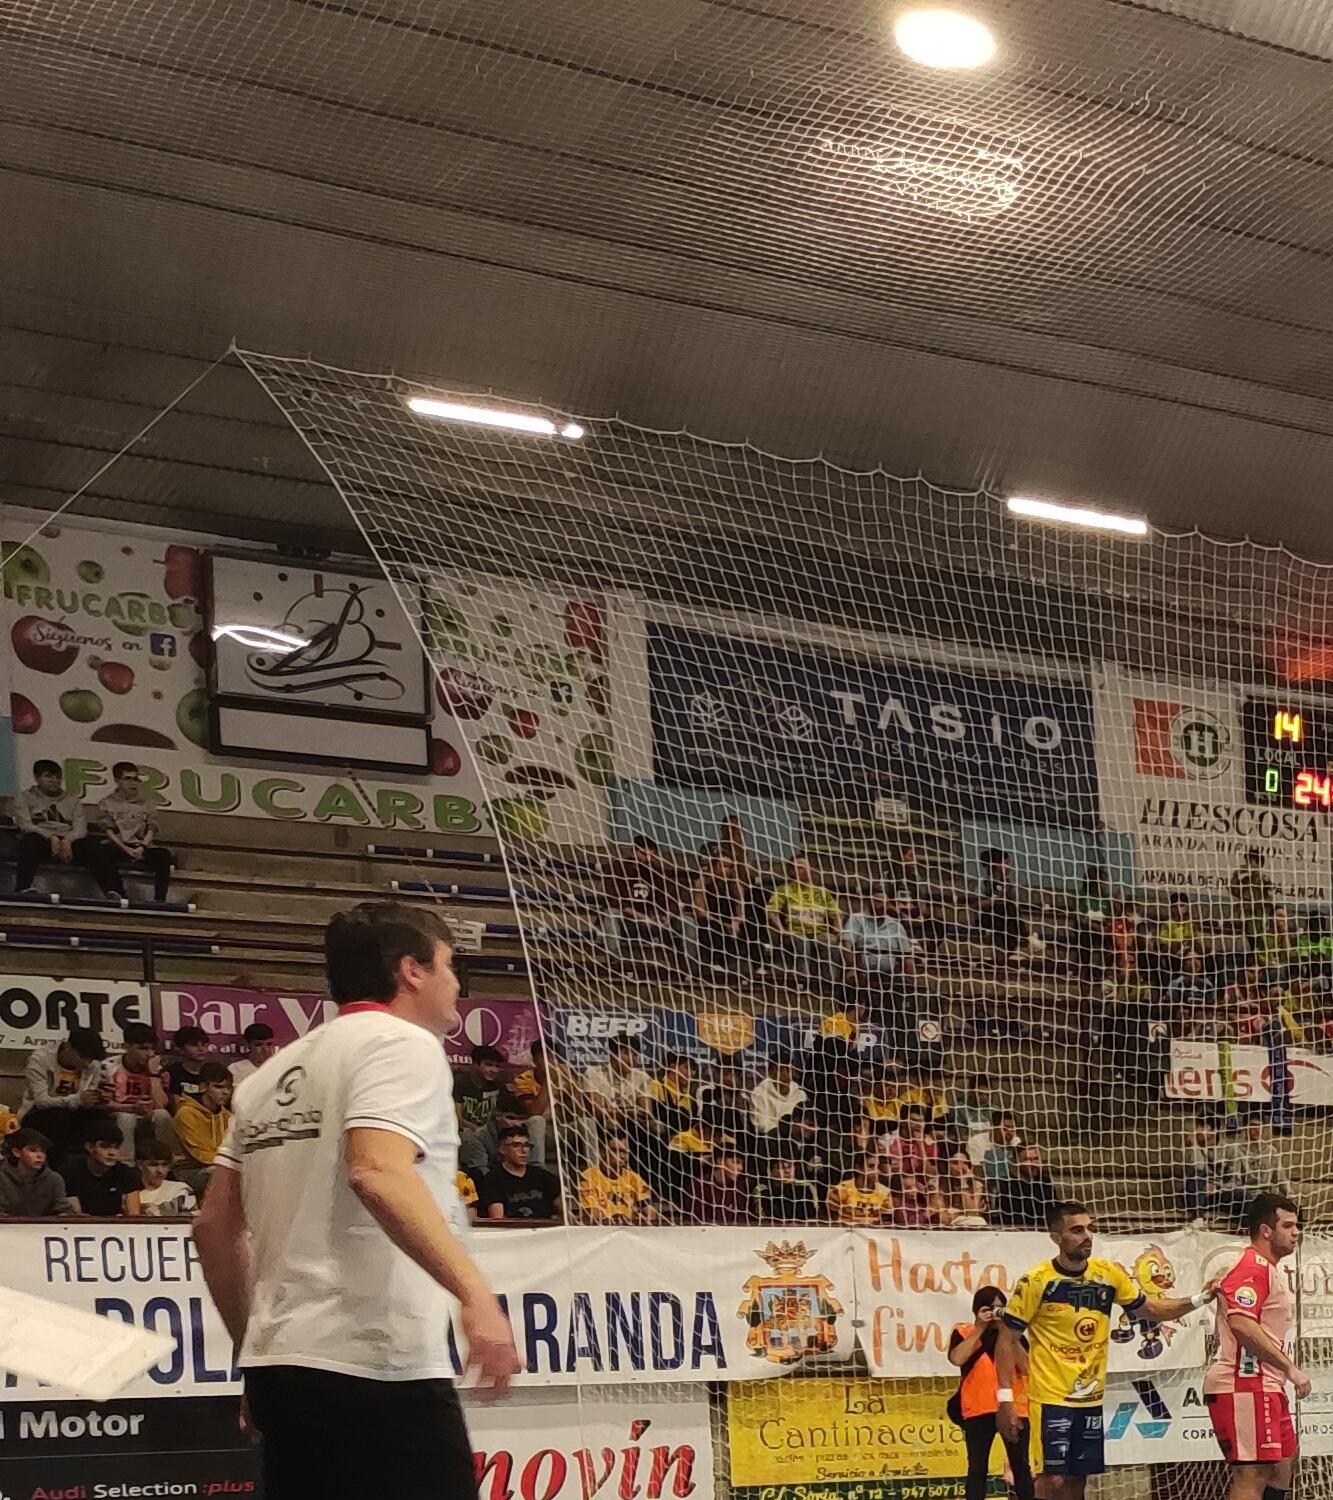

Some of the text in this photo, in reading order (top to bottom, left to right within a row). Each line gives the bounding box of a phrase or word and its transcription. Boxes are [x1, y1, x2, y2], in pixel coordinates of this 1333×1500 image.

[830, 690, 1062, 751] TASIO
[1275, 711, 1300, 742] 14
[1140, 799, 1319, 843] HIESCOSA
[160, 990, 268, 1035] Bar
[866, 1238, 1015, 1295] Hasta
[845, 1385, 886, 1415] La
[20, 1409, 145, 1439] Motor
[760, 1416, 965, 1450] Cantinaccia
[32, 1485, 87, 1500] Audi
[93, 1481, 198, 1499] Selection
[902, 1486, 927, 1499] 947
